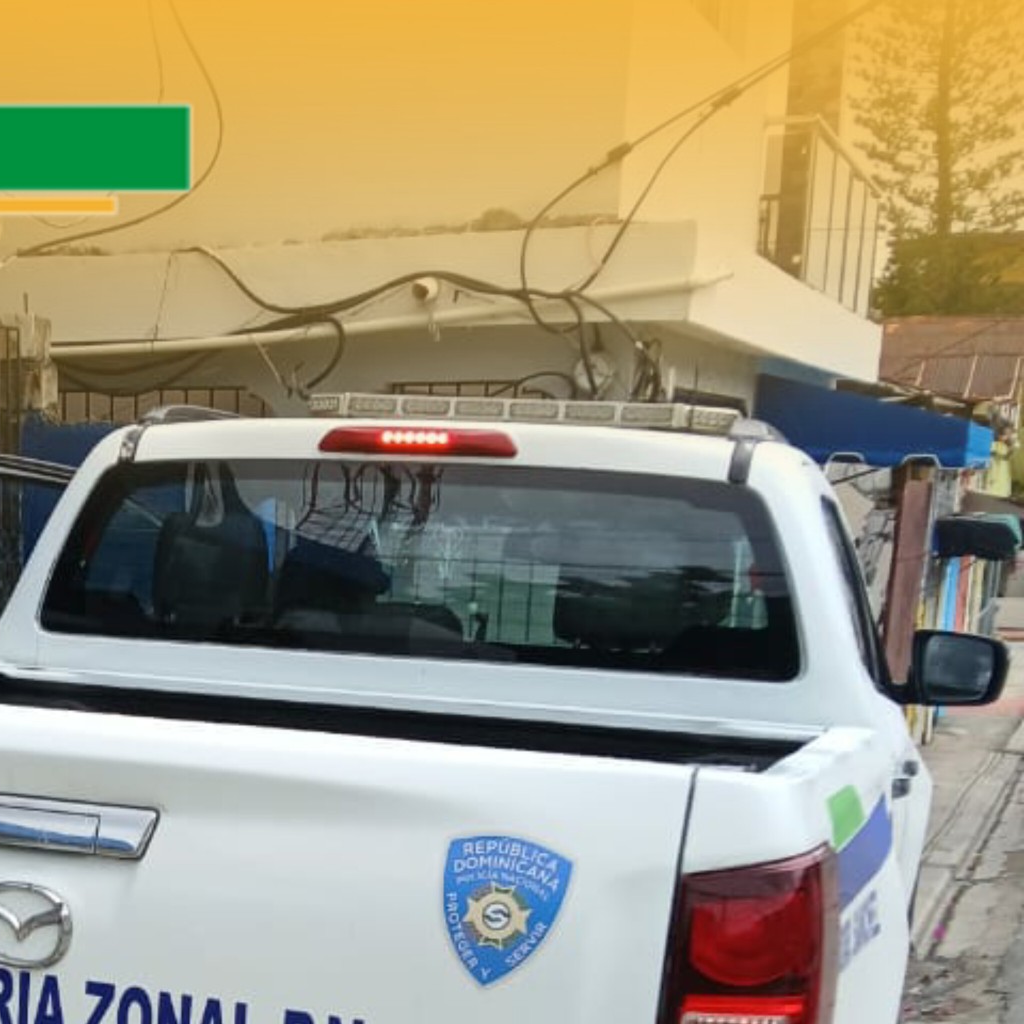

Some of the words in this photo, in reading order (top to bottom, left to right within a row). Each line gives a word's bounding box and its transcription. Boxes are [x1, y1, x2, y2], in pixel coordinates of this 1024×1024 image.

[453, 854, 560, 891] DOMINICANA
[446, 892, 479, 969] PROTEGER
[480, 968, 492, 980] Y
[504, 922, 548, 967] SERVIR
